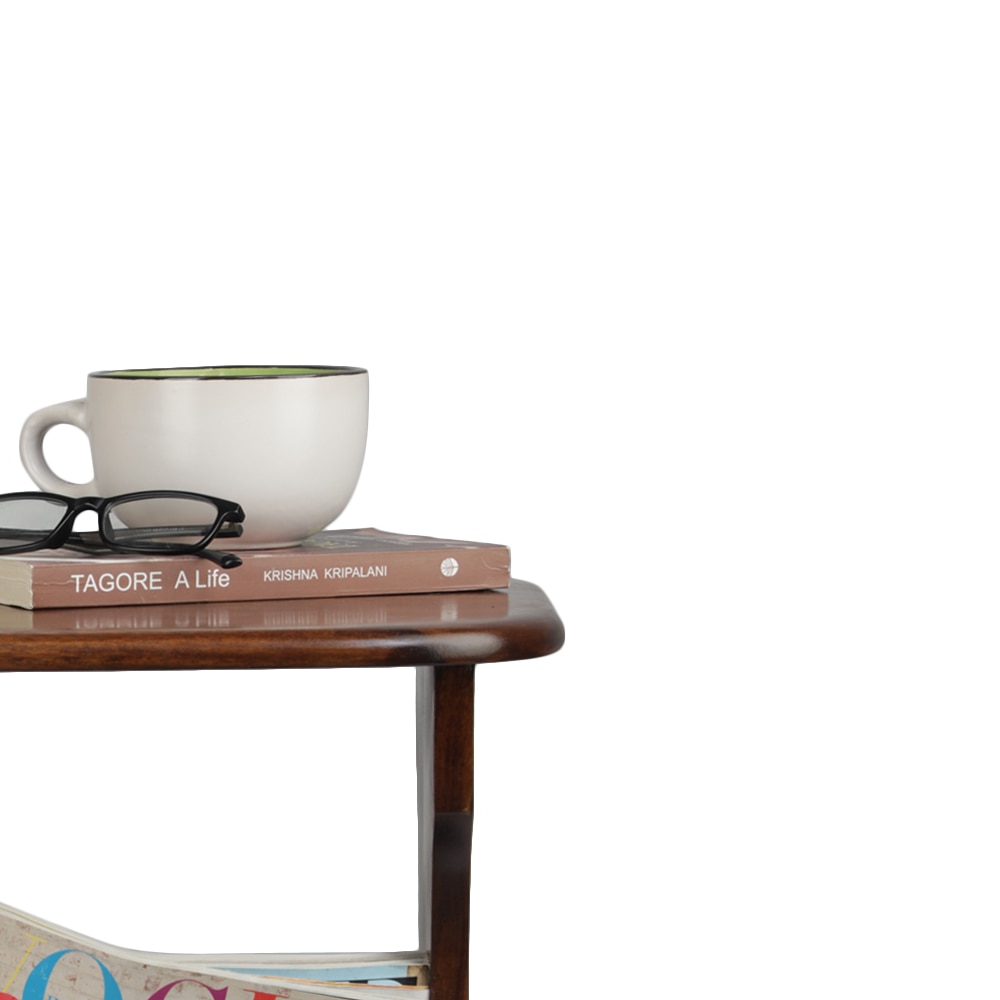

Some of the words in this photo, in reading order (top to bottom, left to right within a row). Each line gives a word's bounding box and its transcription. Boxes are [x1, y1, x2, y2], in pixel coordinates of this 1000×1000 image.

[71, 571, 162, 593] TAGORE
[174, 570, 190, 589] A
[195, 569, 230, 588] Life
[263, 568, 318, 582] KRISHNA
[324, 565, 388, 579] KRIPALANI
